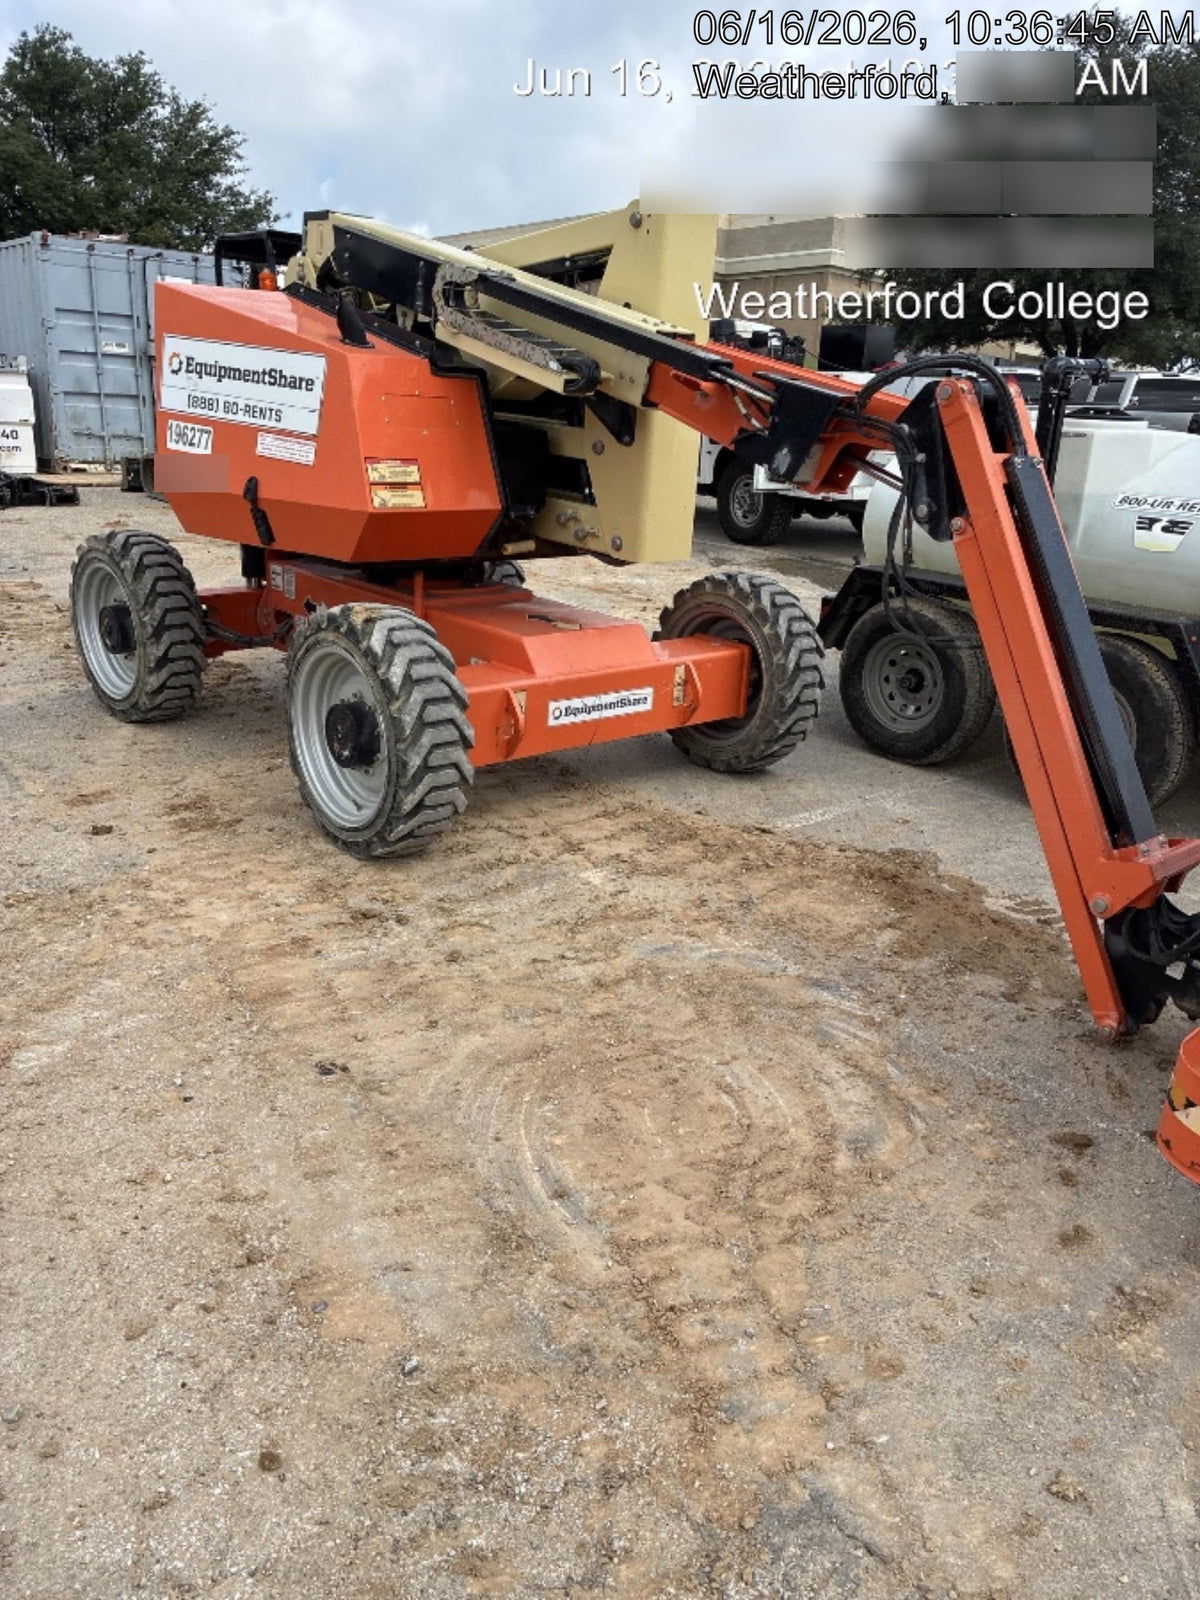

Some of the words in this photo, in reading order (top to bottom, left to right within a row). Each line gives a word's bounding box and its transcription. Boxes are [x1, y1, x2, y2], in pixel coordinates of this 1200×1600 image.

[184, 355, 316, 392] EquipmentShare
[186, 393, 220, 413] (888)
[222, 400, 283, 424] GO-RENTS
[168, 421, 212, 450] 196277
[564, 696, 649, 718] EquipmentShare
